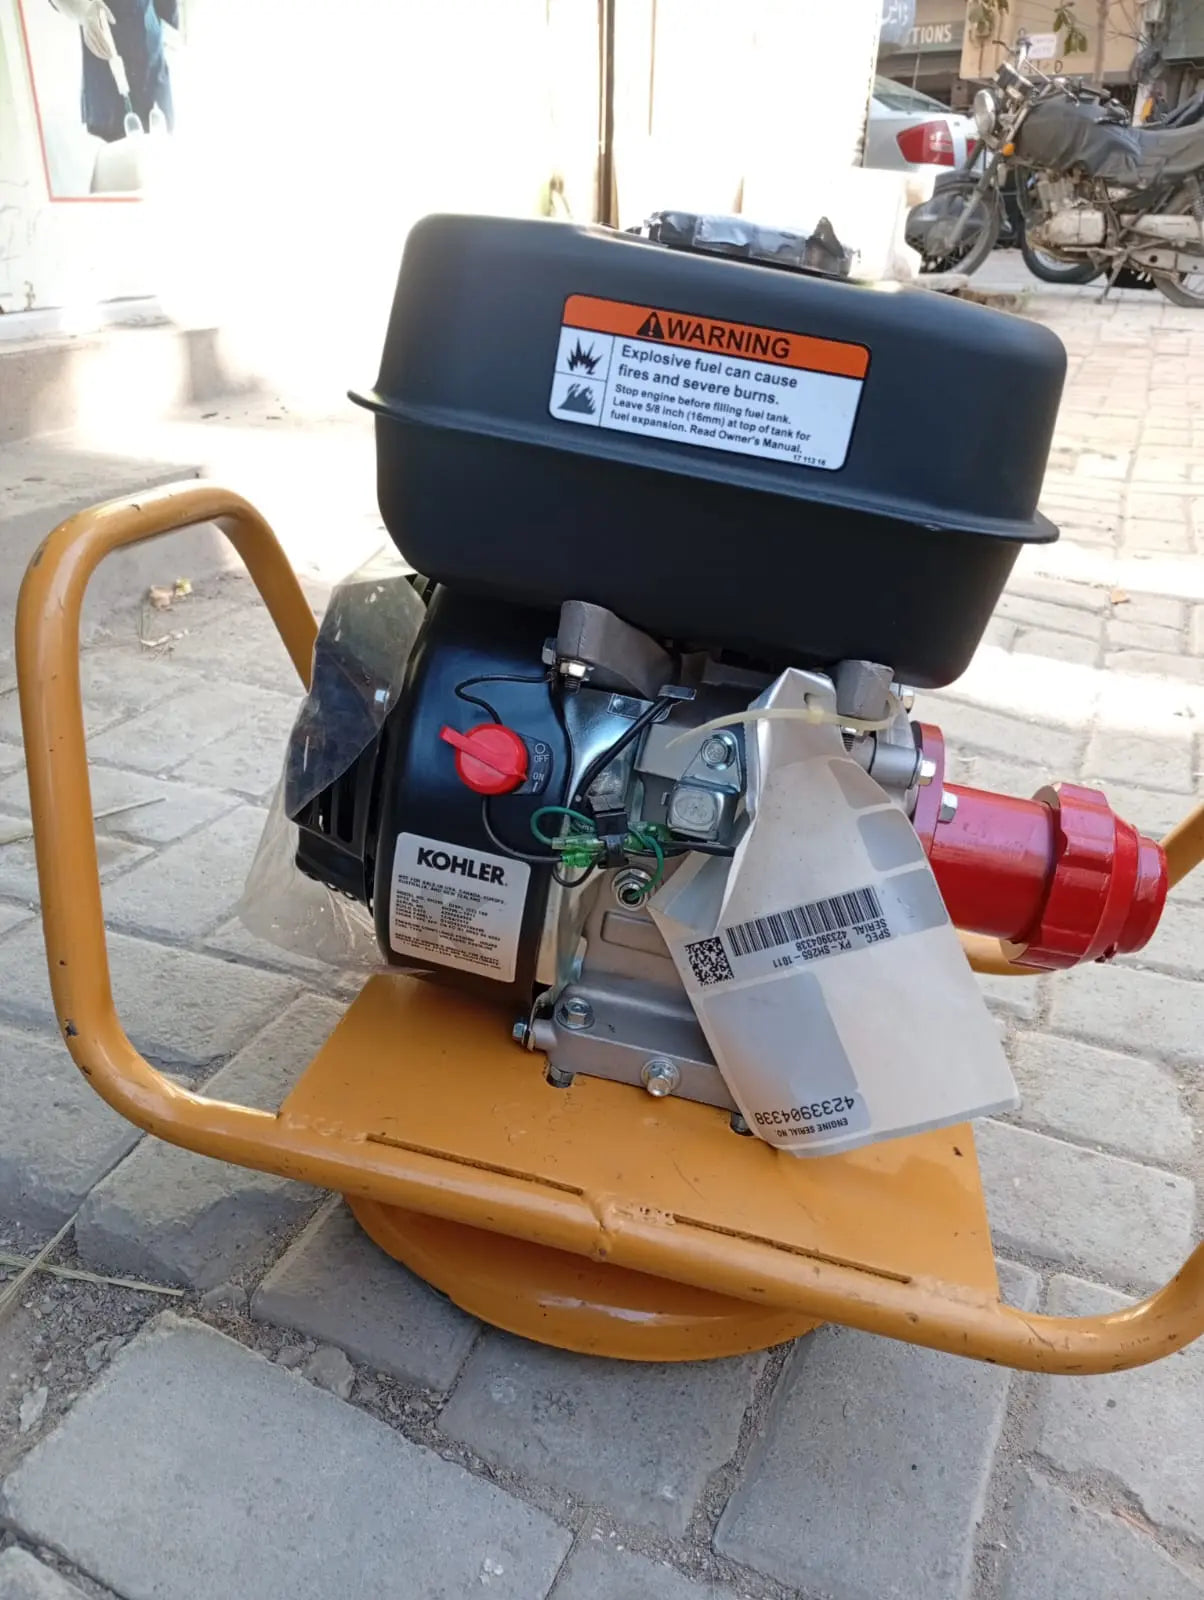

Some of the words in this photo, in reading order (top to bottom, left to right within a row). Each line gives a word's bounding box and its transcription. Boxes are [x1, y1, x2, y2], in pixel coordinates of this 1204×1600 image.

[668, 318, 791, 359] WARNING
[621, 344, 691, 369] Explosive
[695, 358, 722, 374] fuel
[725, 366, 751, 380] can
[754, 372, 798, 388] cause
[618, 363, 649, 381] fires
[652, 373, 680, 387] and
[682, 378, 730, 396] severe
[733, 384, 779, 405] burns.
[613, 396, 643, 410] Leave
[645, 402, 661, 414] 5/8
[662, 406, 684, 418] inch
[686, 411, 725, 428] (16mm)
[727, 419, 738, 428] at
[739, 421, 756, 433] top
[758, 424, 770, 434] of
[771, 427, 793, 438] tank
[795, 430, 811, 441] for
[615, 383, 639, 397] Stop
[641, 390, 676, 403] engine
[678, 395, 711, 410] before
[713, 402, 743, 418] filling
[744, 407, 765, 419] fuel
[766, 412, 791, 424] tank.
[610, 409, 630, 421] fuel
[631, 415, 687, 432] expansion.
[689, 424, 716, 438] Read
[718, 430, 760, 446] Owner's
[762, 437, 802, 453] Manual.
[534, 754, 551, 762] OFF
[533, 772, 545, 781] ON
[417, 847, 505, 887] KOHLER
[795, 930, 847, 951] 4233904338
[852, 918, 887, 935] SERIAL
[865, 928, 891, 944] SPEC
[754, 1095, 855, 1125] 4233904338
[817, 1117, 849, 1132] ENGINE
[788, 1125, 816, 1137] SERIAL
